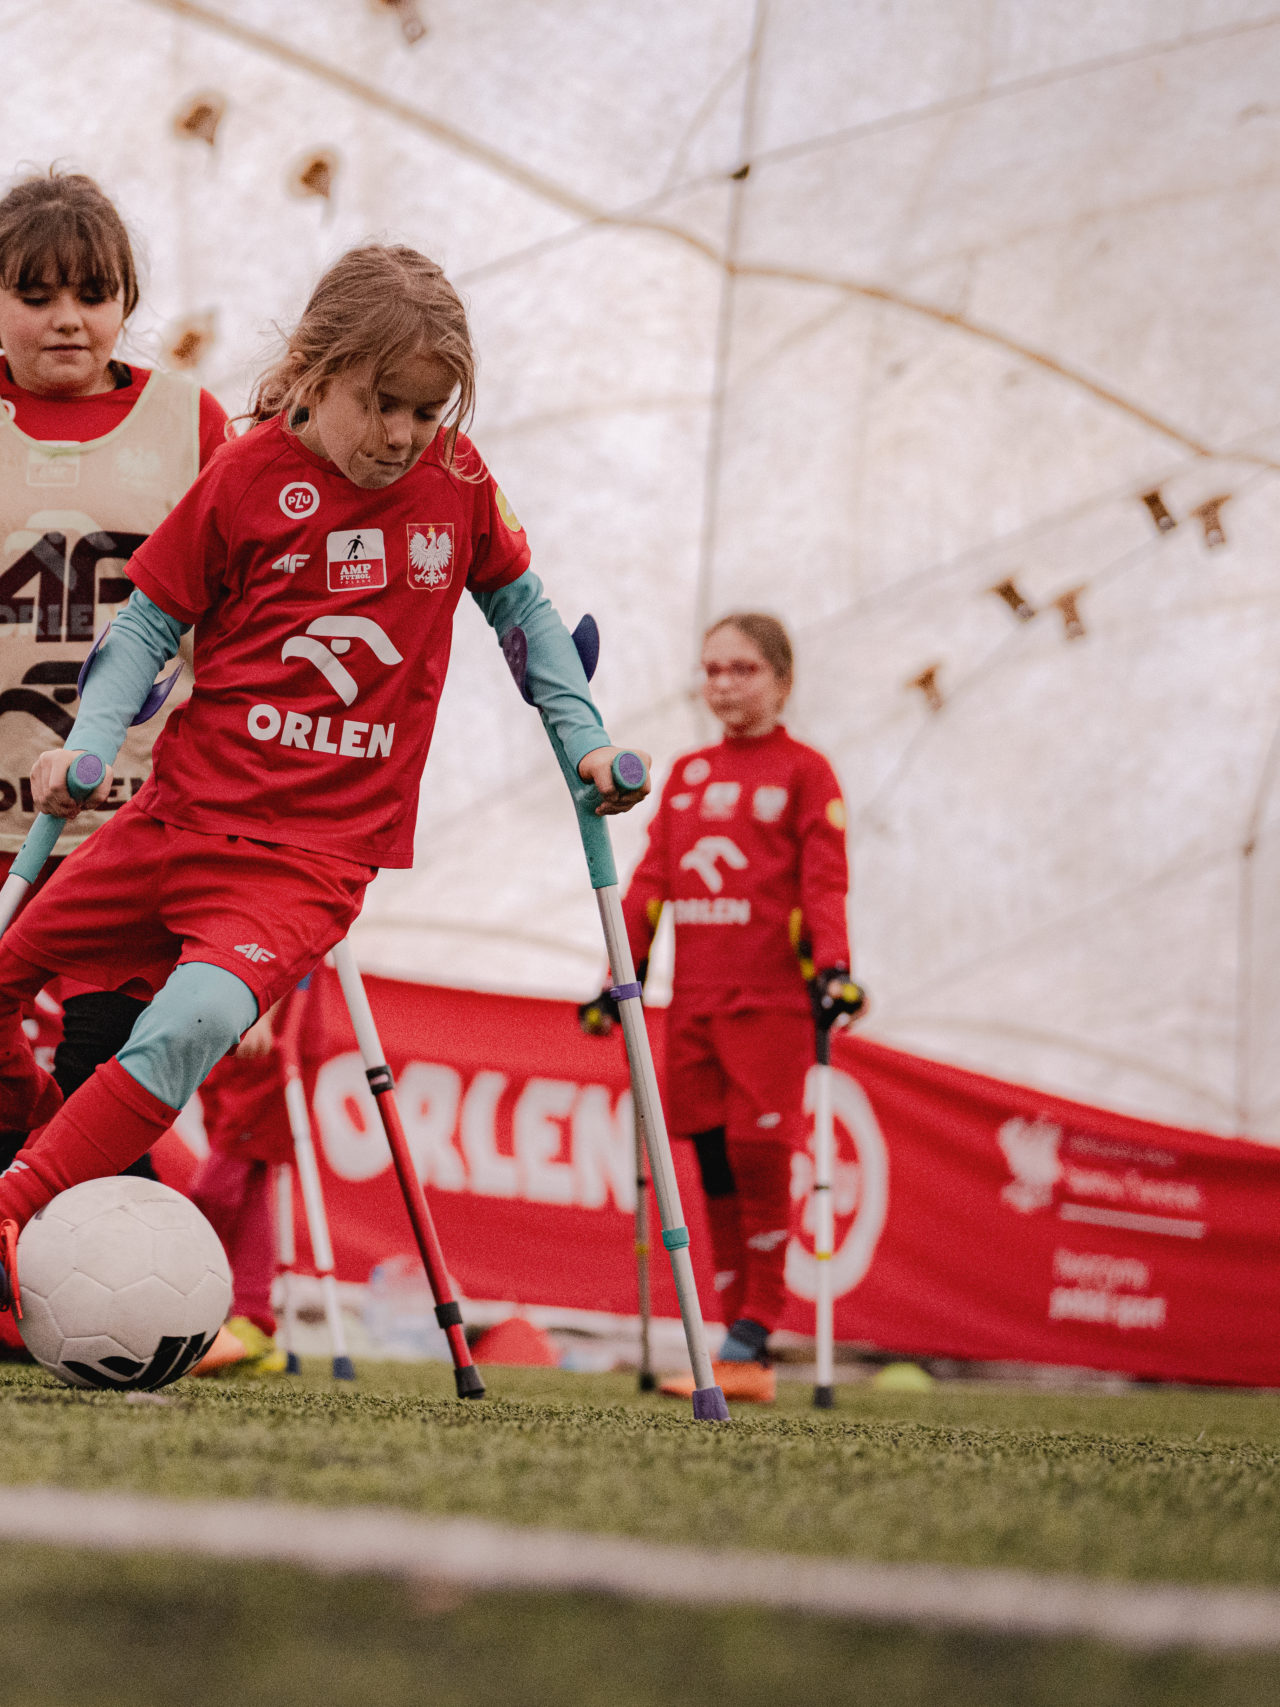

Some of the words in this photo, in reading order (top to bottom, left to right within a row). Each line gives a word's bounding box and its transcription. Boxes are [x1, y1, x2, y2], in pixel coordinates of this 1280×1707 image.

[287, 491, 311, 510] PZU
[271, 553, 311, 574] 4F
[340, 563, 372, 576] AMP
[247, 703, 396, 759] ORLEN
[233, 943, 277, 963] 4F
[313, 1050, 638, 1214] ORLEN
